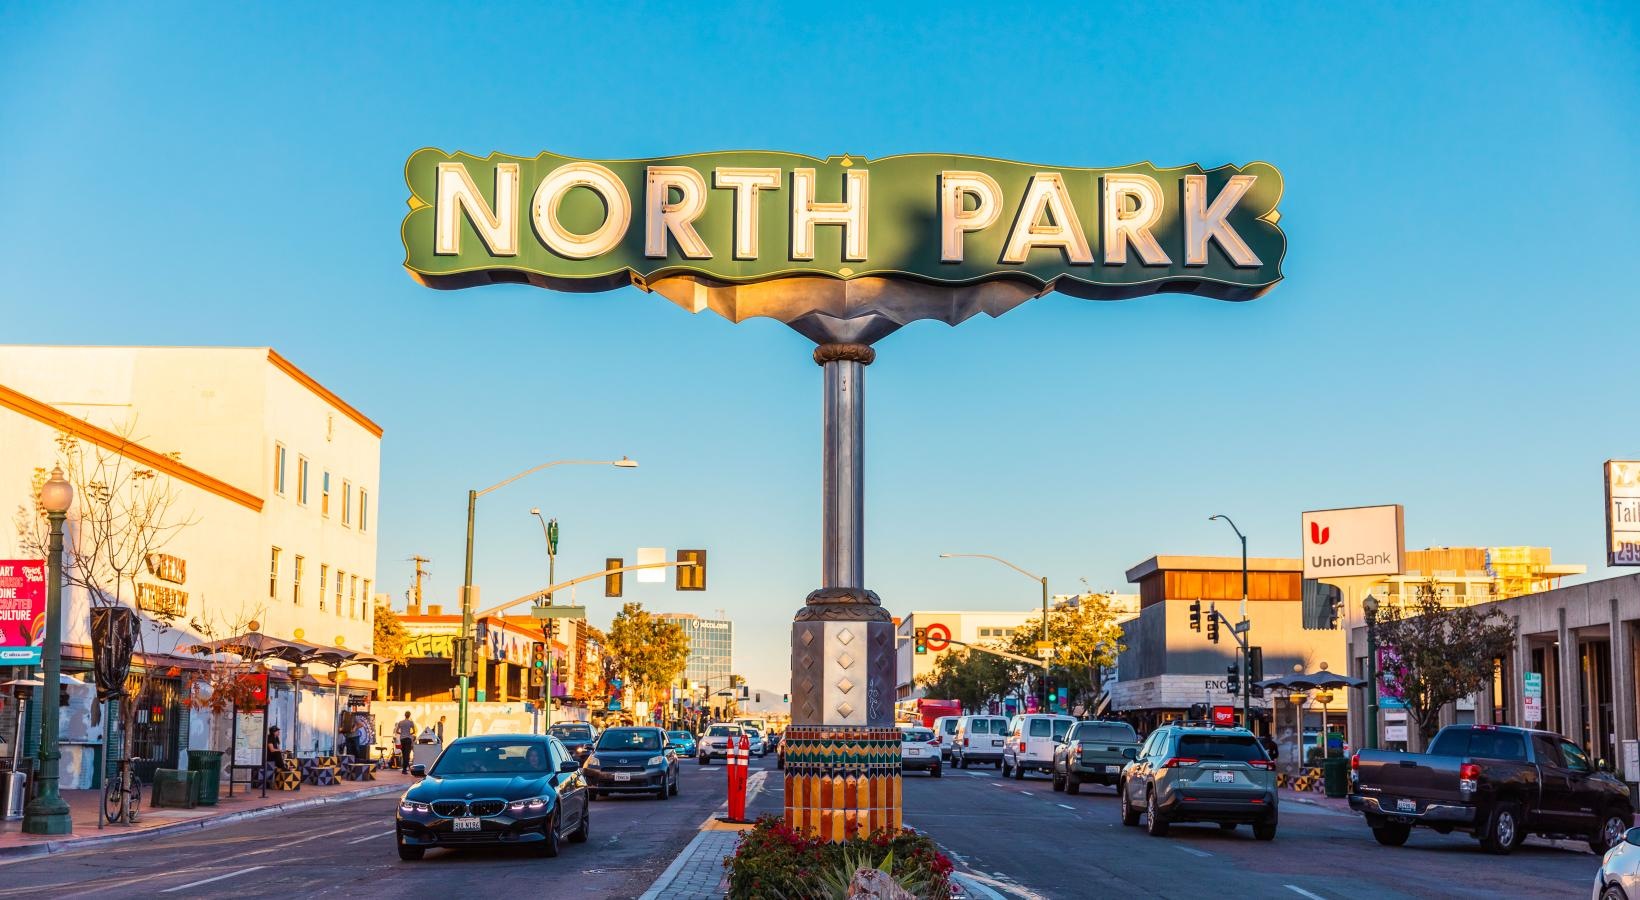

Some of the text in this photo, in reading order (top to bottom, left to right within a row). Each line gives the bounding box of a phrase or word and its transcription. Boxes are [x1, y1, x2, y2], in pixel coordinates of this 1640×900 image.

[435, 161, 1263, 267] NORTH PARK
[1312, 552, 1391, 568] UnionBank
